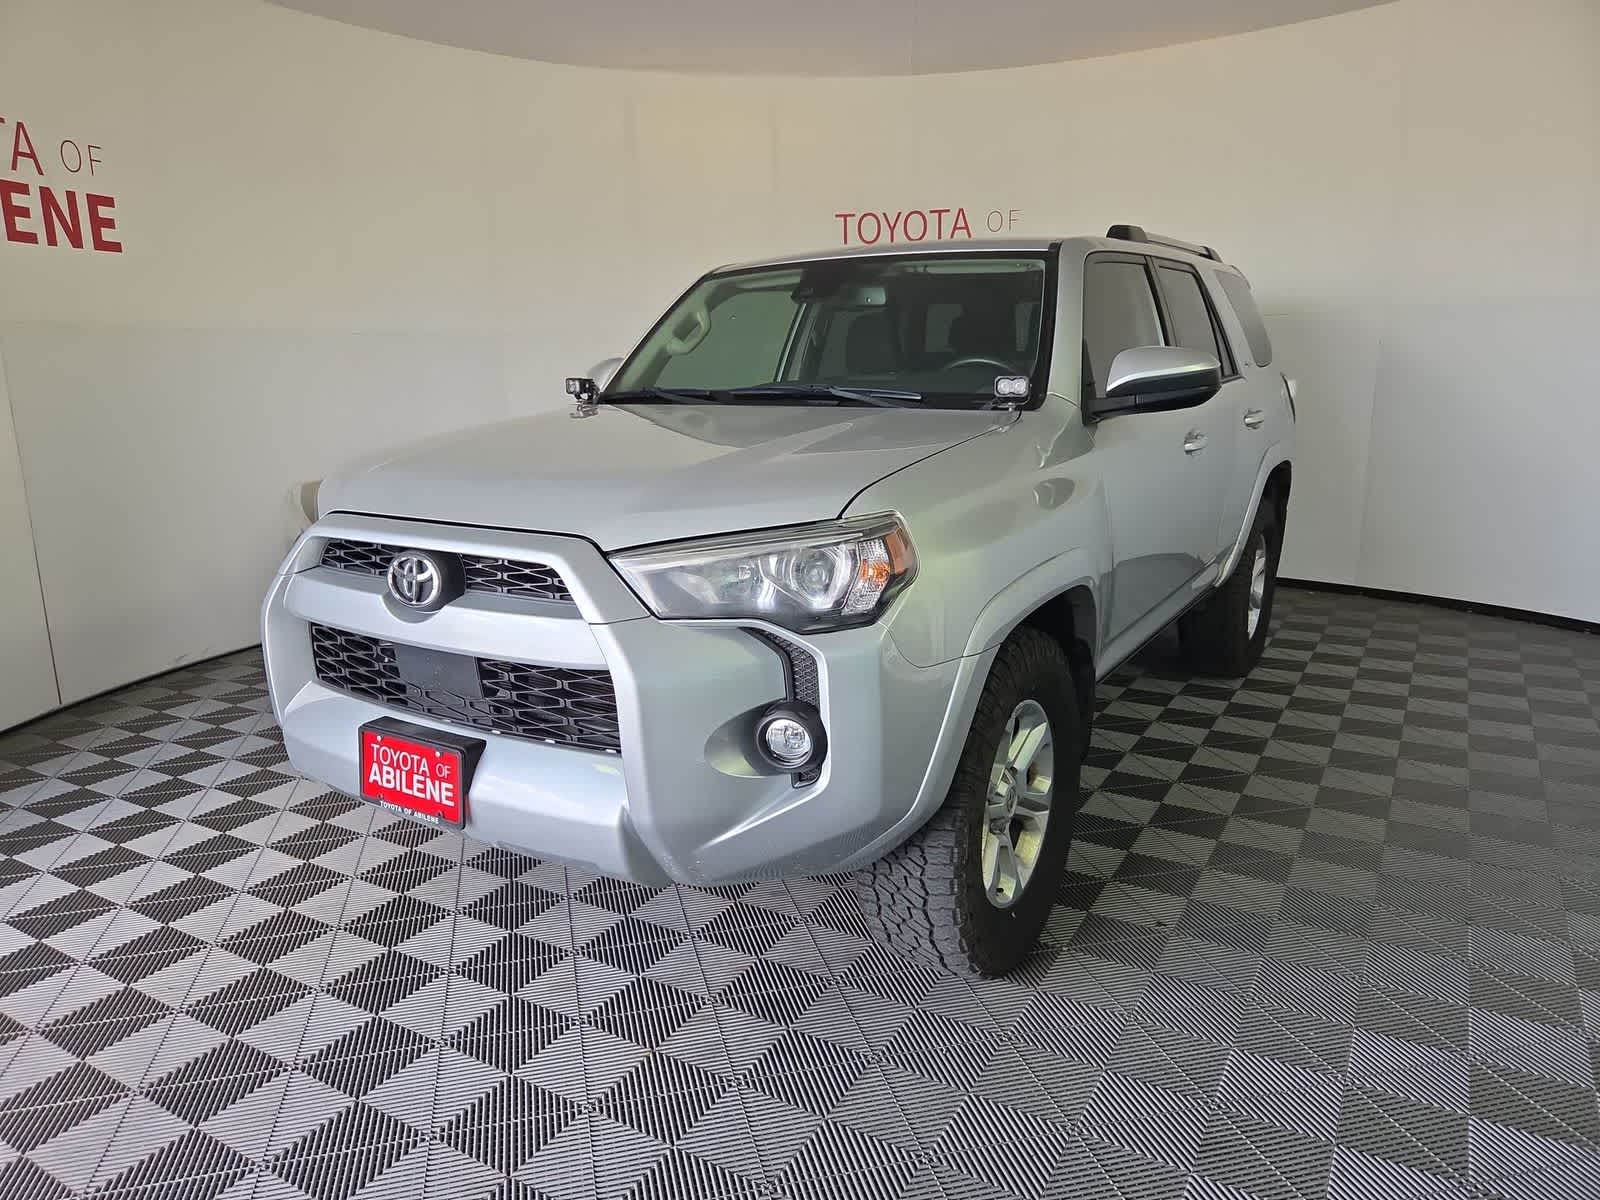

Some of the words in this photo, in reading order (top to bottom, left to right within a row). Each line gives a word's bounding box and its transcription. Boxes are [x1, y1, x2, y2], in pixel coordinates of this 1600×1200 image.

[0, 116, 44, 176] A
[60, 139, 102, 177] OF
[834, 207, 972, 245] TOYOTA
[986, 208, 1025, 233] OF
[370, 743, 430, 777] TOYOTA
[435, 763, 452, 779] OF
[368, 762, 455, 807] ABILENE
[380, 800, 402, 812] TOYOTA
[403, 808, 412, 816] OF
[413, 811, 440, 824] ABILENE
